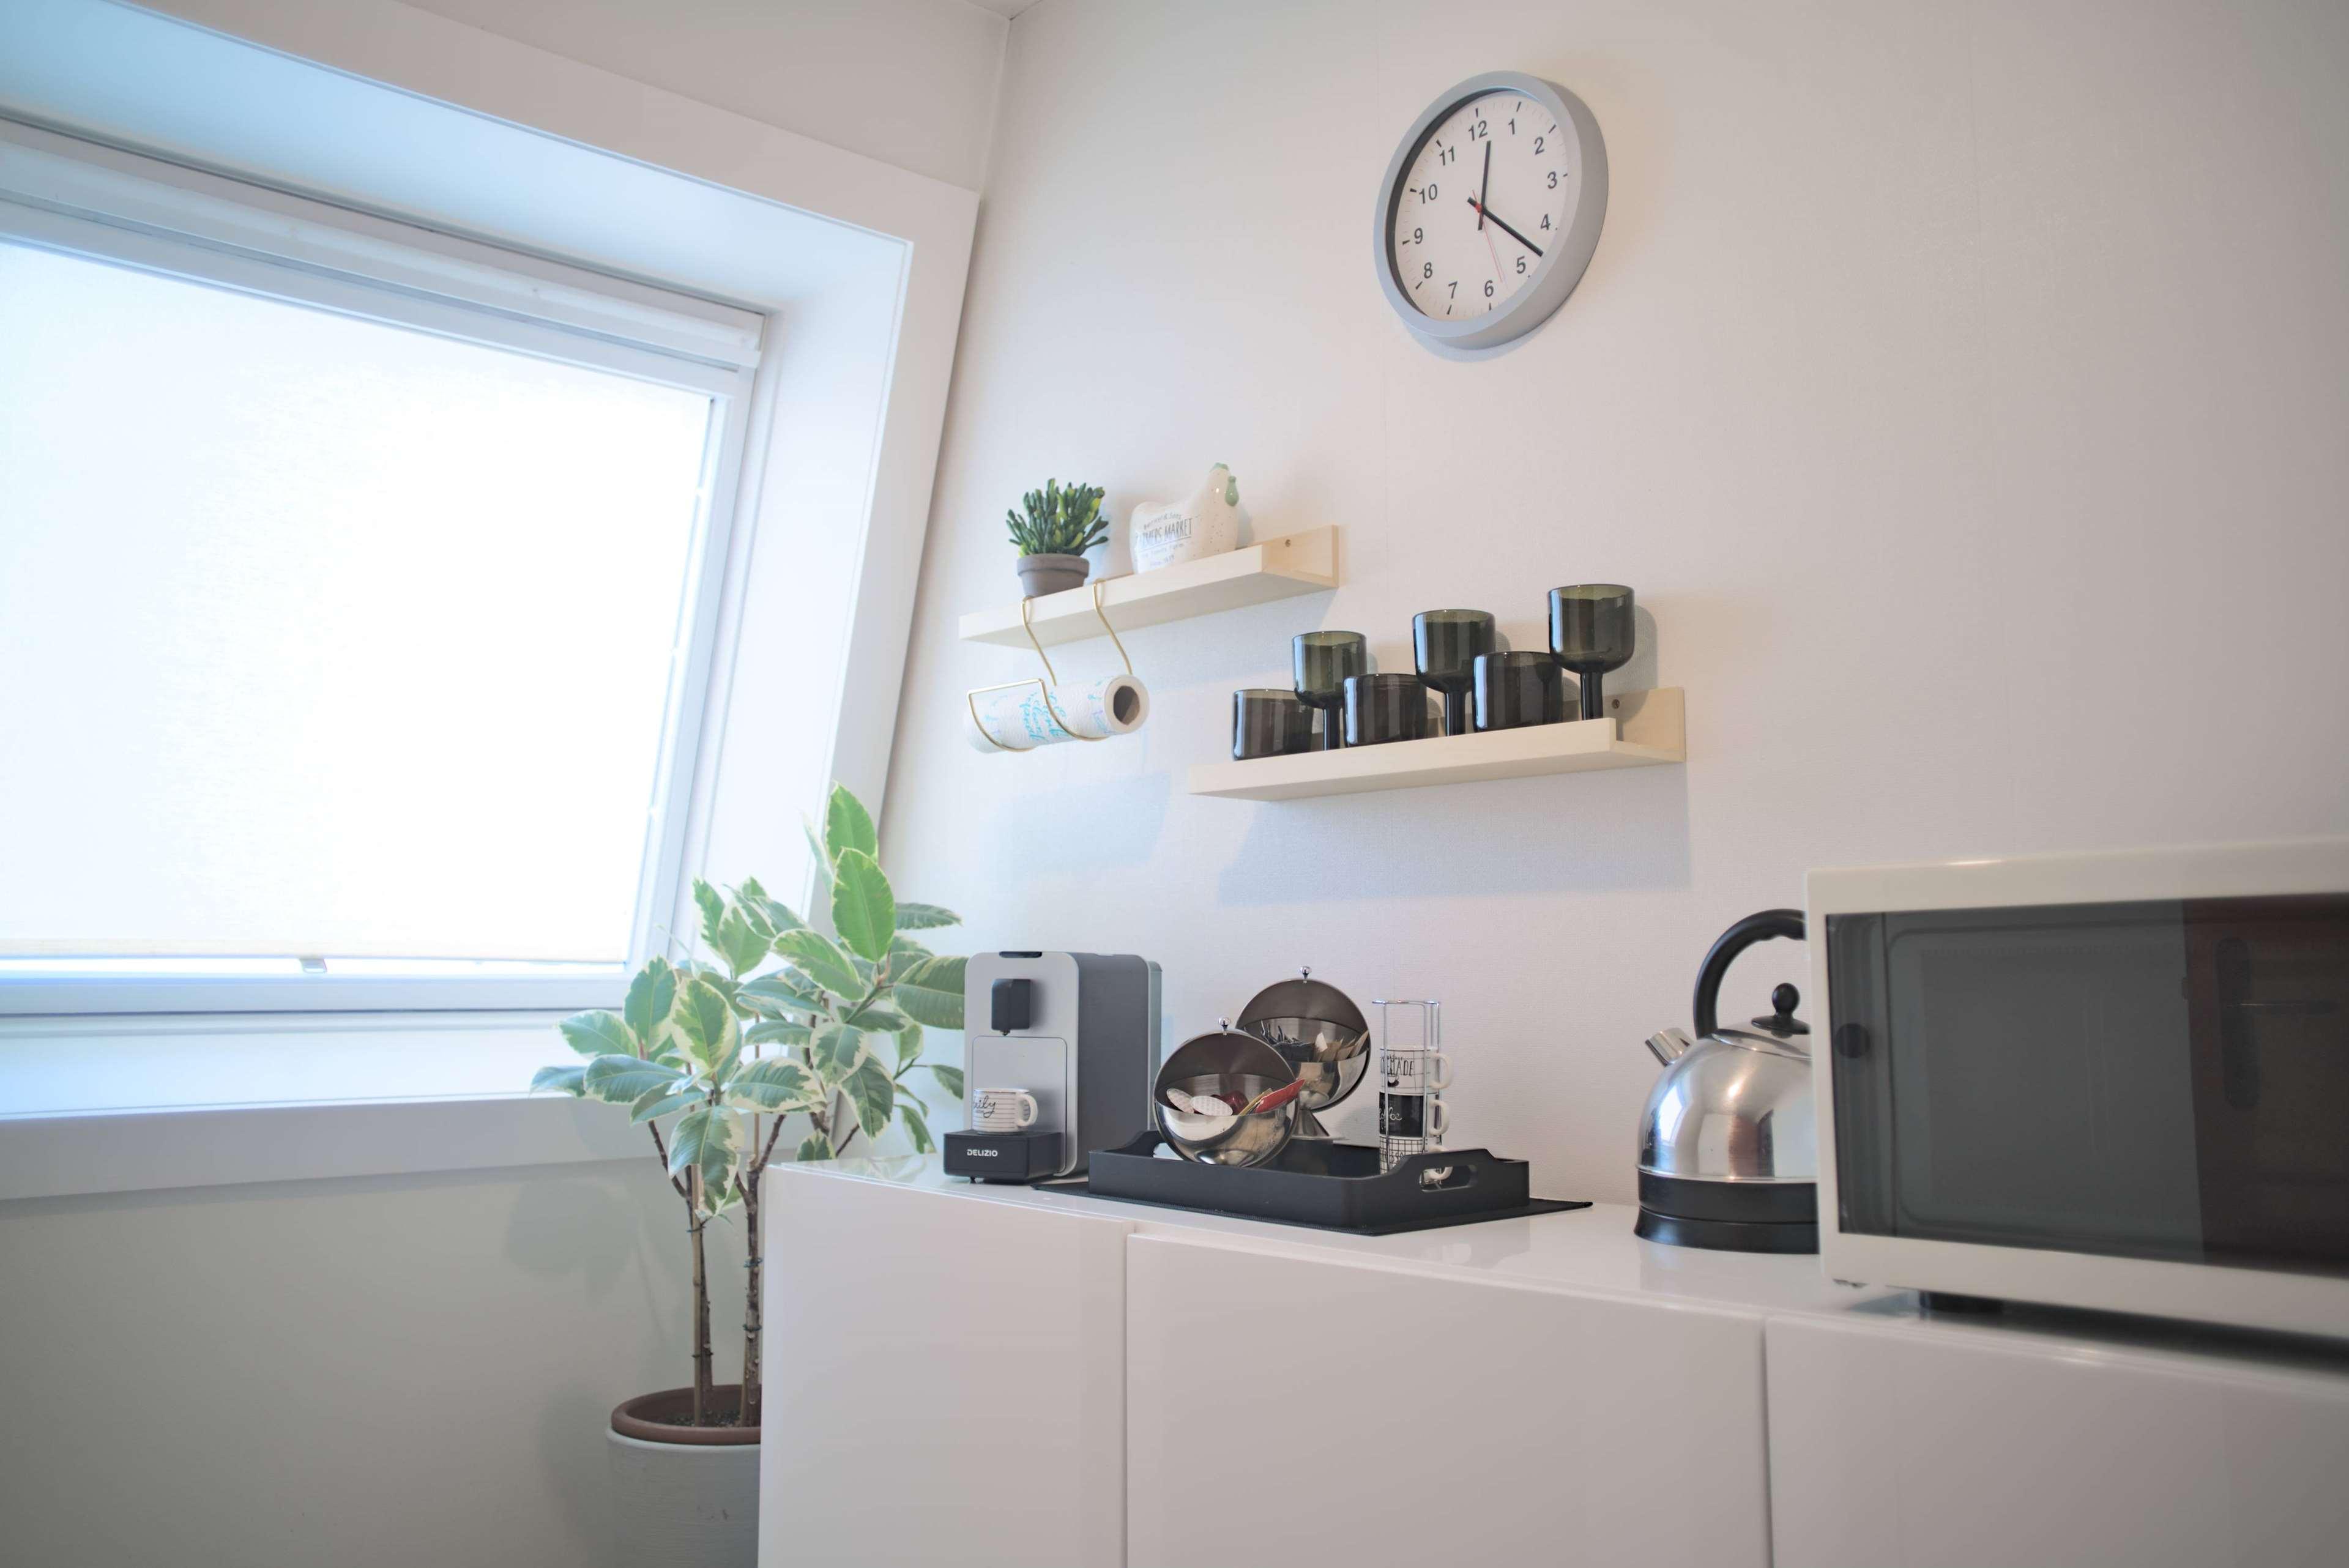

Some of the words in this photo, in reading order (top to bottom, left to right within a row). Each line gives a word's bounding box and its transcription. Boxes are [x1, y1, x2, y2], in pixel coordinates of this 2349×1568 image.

[1468, 120, 1488, 141] 12
[1508, 118, 1515, 135] 1
[1534, 136, 1544, 155] 2
[1439, 146, 1455, 166] 11
[1547, 171, 1557, 190] 3
[1418, 184, 1438, 204] 10
[1540, 214, 1550, 231] 4
[1413, 228, 1423, 245] 9
[1423, 262, 1433, 279] 8
[1516, 256, 1526, 274] 5
[1448, 281, 1457, 299] 7
[1484, 280, 1494, 297] 6
[1164, 519, 1193, 540] MARKET
[967, 1148, 998, 1157] DELIZIO
